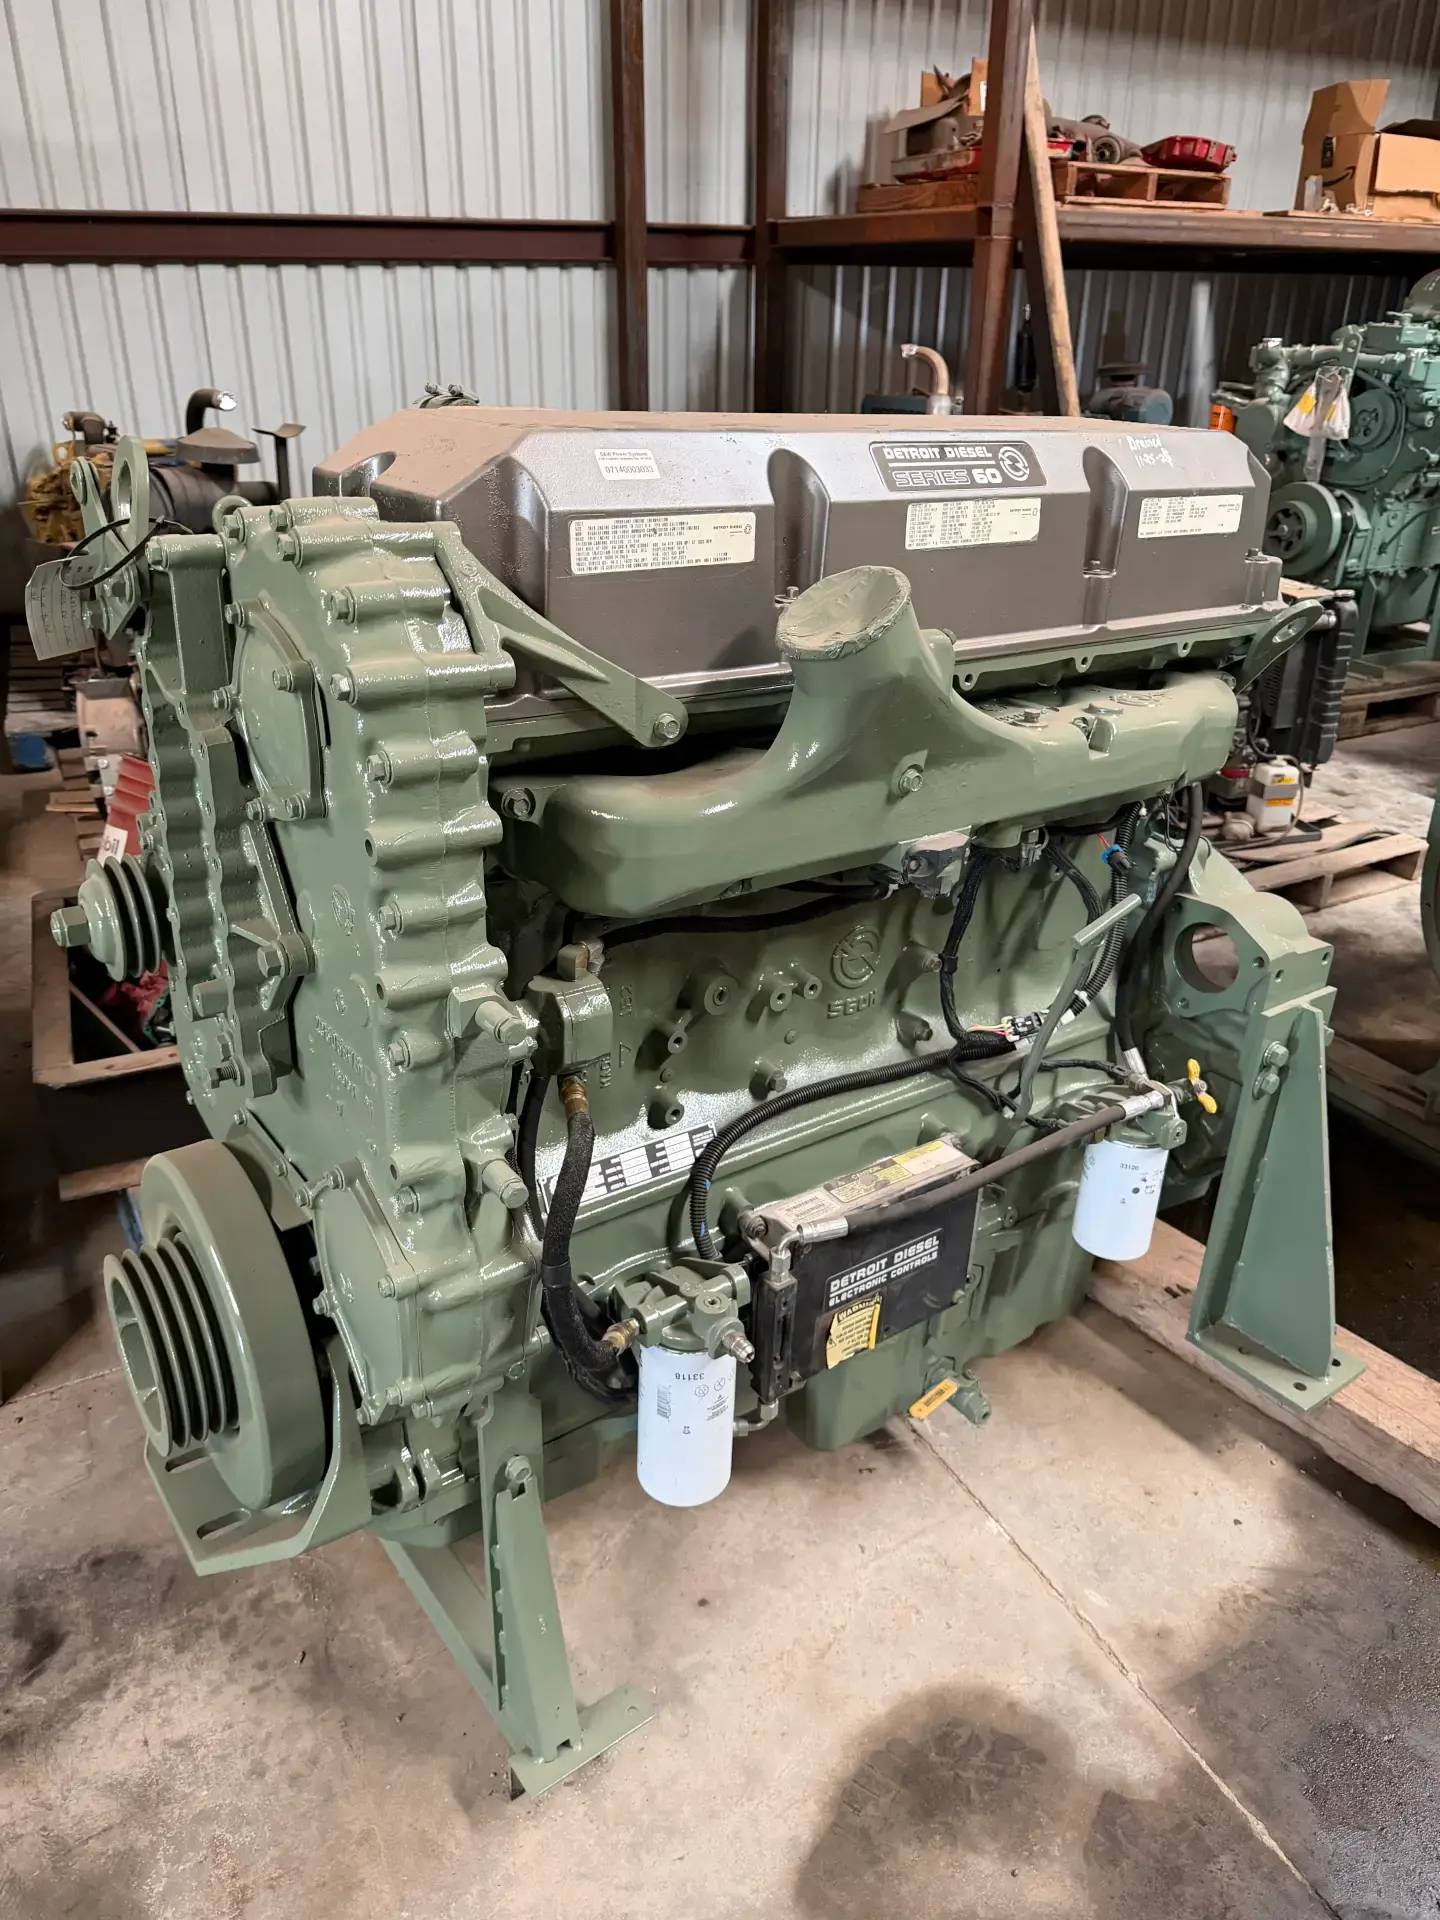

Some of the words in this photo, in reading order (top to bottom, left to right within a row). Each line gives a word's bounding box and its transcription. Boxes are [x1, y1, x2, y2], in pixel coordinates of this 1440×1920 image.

[882, 446, 941, 460] DETROIT
[944, 446, 993, 459] DIESEL
[892, 468, 971, 487] SERIES
[971, 468, 1003, 484] 60
[830, 1258, 889, 1292] DETROIT
[893, 1235, 940, 1263] DIESEL
[829, 1274, 888, 1307] ELECTRONIC
[890, 1251, 938, 1278] CONTROLS
[675, 1372, 705, 1381] 33118
